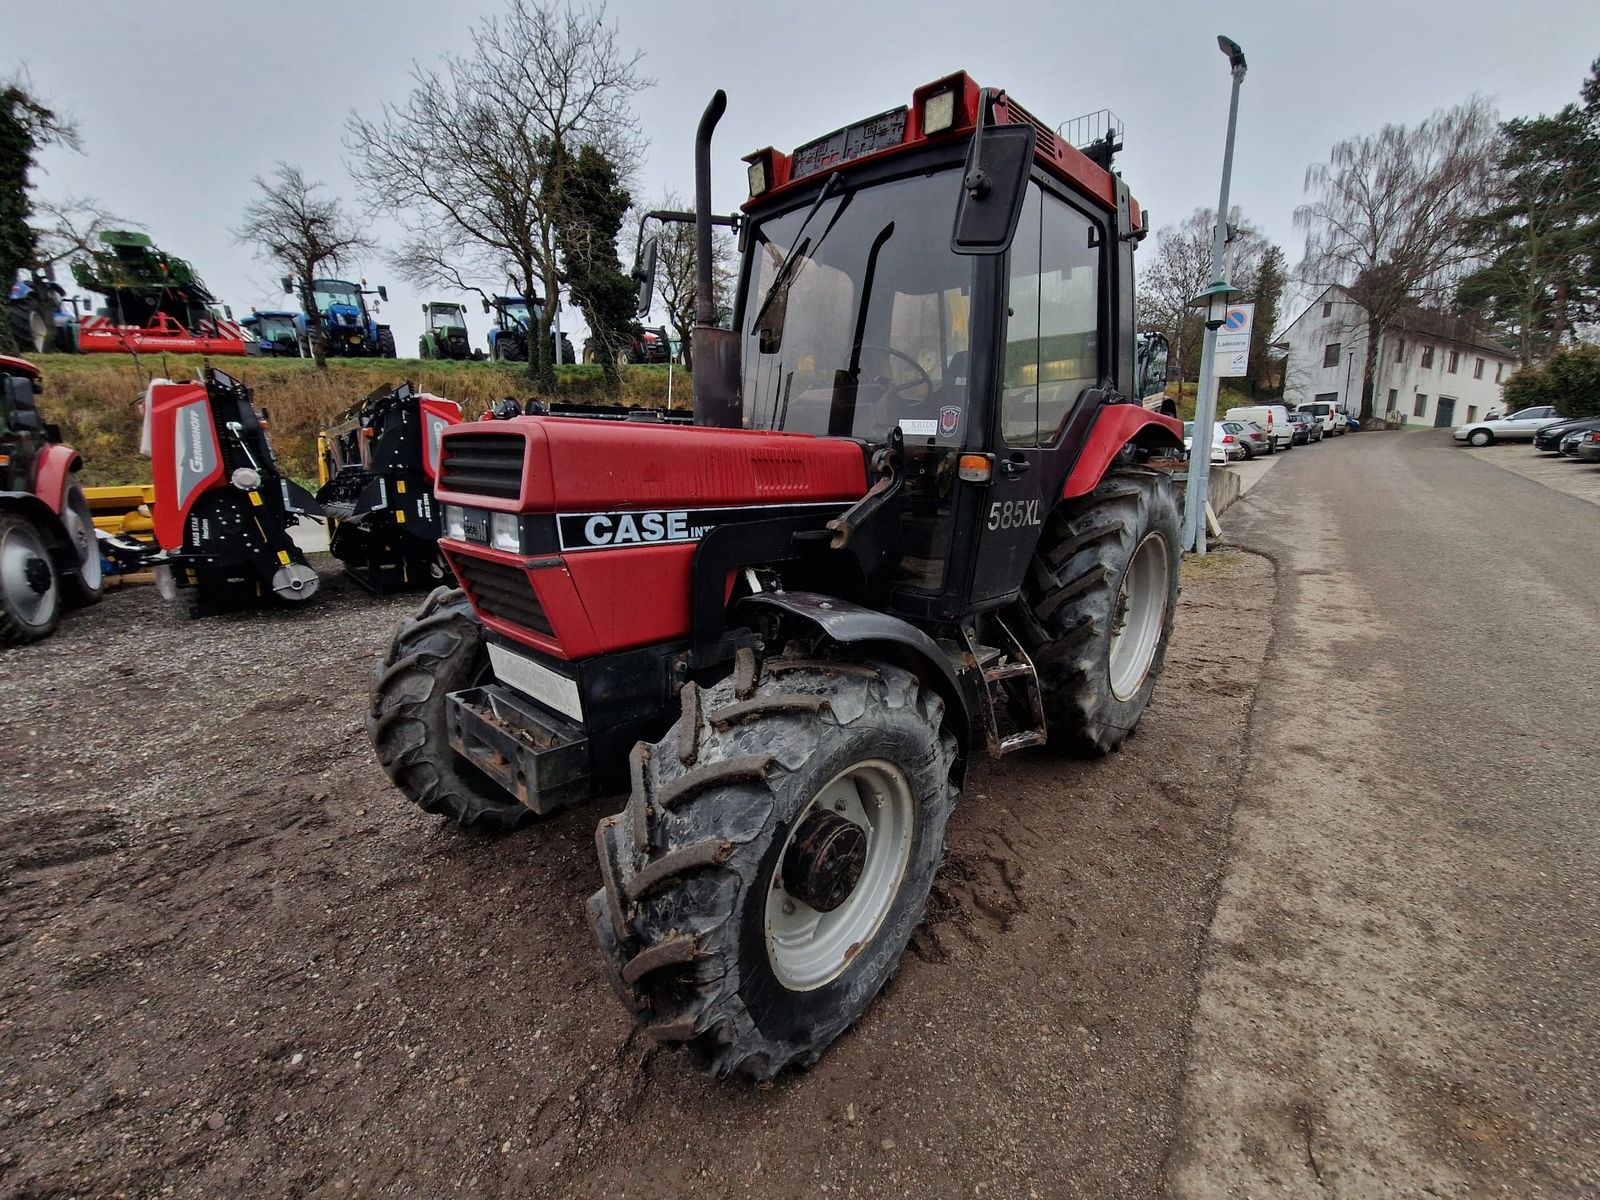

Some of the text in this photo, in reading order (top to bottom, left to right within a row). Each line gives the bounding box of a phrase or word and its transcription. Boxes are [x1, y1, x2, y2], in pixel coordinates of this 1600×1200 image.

[1217, 340, 1247, 348] Ladezone
[584, 512, 689, 545] CASE
[987, 499, 1041, 531] 585XL
